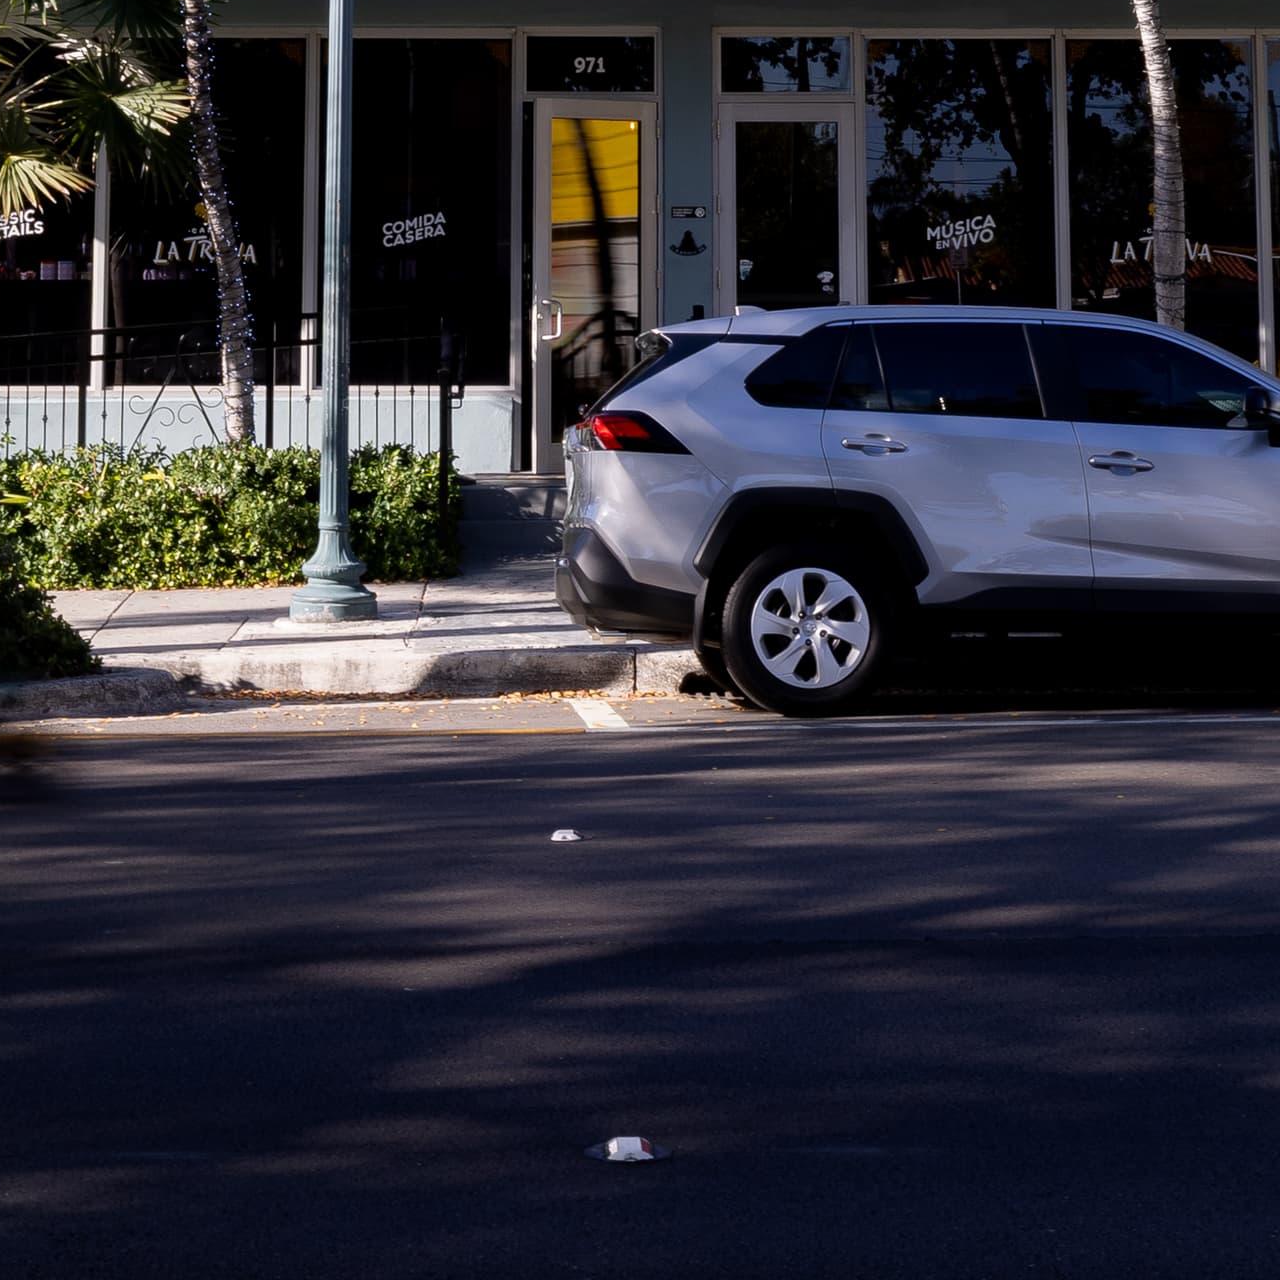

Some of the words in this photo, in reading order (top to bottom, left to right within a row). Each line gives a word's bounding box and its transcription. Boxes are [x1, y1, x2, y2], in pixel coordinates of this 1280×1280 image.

[574, 56, 606, 74] 971
[382, 211, 446, 235] COMIDA
[926, 214, 996, 241] MÚSICA
[382, 224, 446, 247] CASERA
[935, 239, 950, 250] EN
[950, 228, 994, 250] VIVO
[153, 240, 180, 264] LA
[1110, 240, 1136, 264] LA
[1139, 236, 1211, 263] TVA
